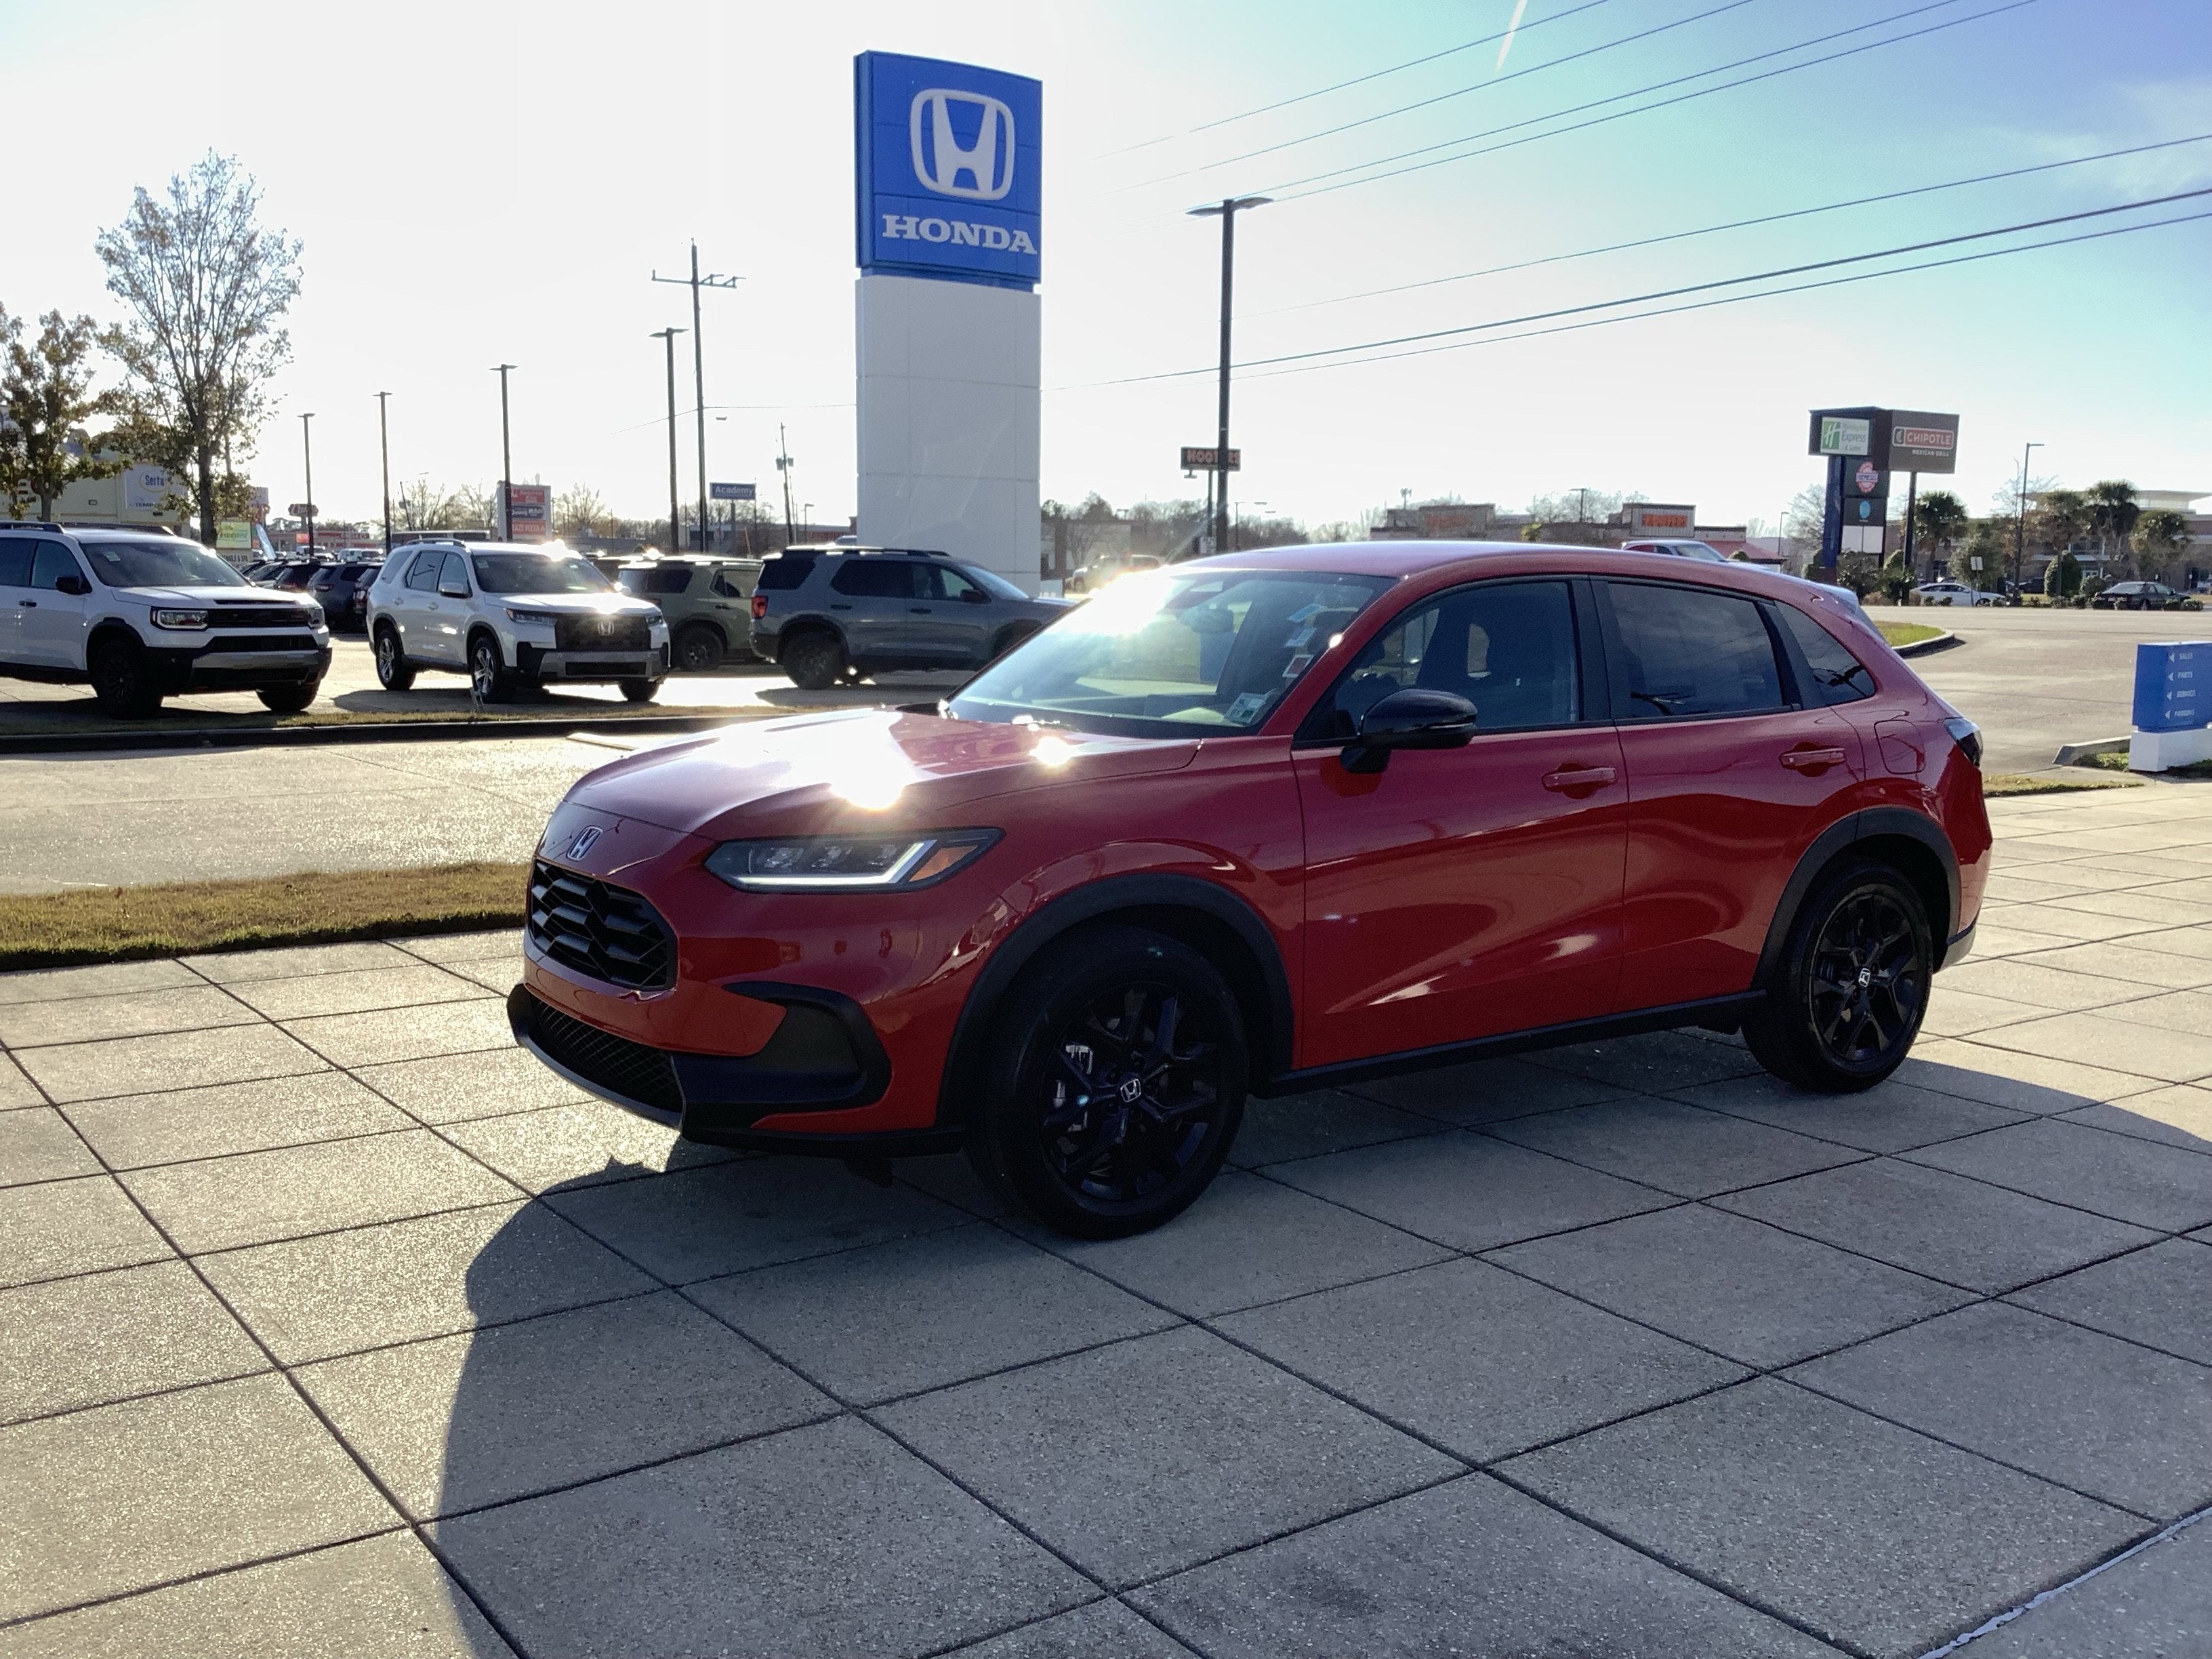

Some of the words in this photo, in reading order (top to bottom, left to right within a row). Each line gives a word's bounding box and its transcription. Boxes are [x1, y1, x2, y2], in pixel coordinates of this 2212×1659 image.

[882, 213, 1038, 255] HONDA
[1842, 431, 1867, 443] Express
[1907, 432, 1952, 445] CHIPOTLE
[715, 485, 753, 496] Academy
